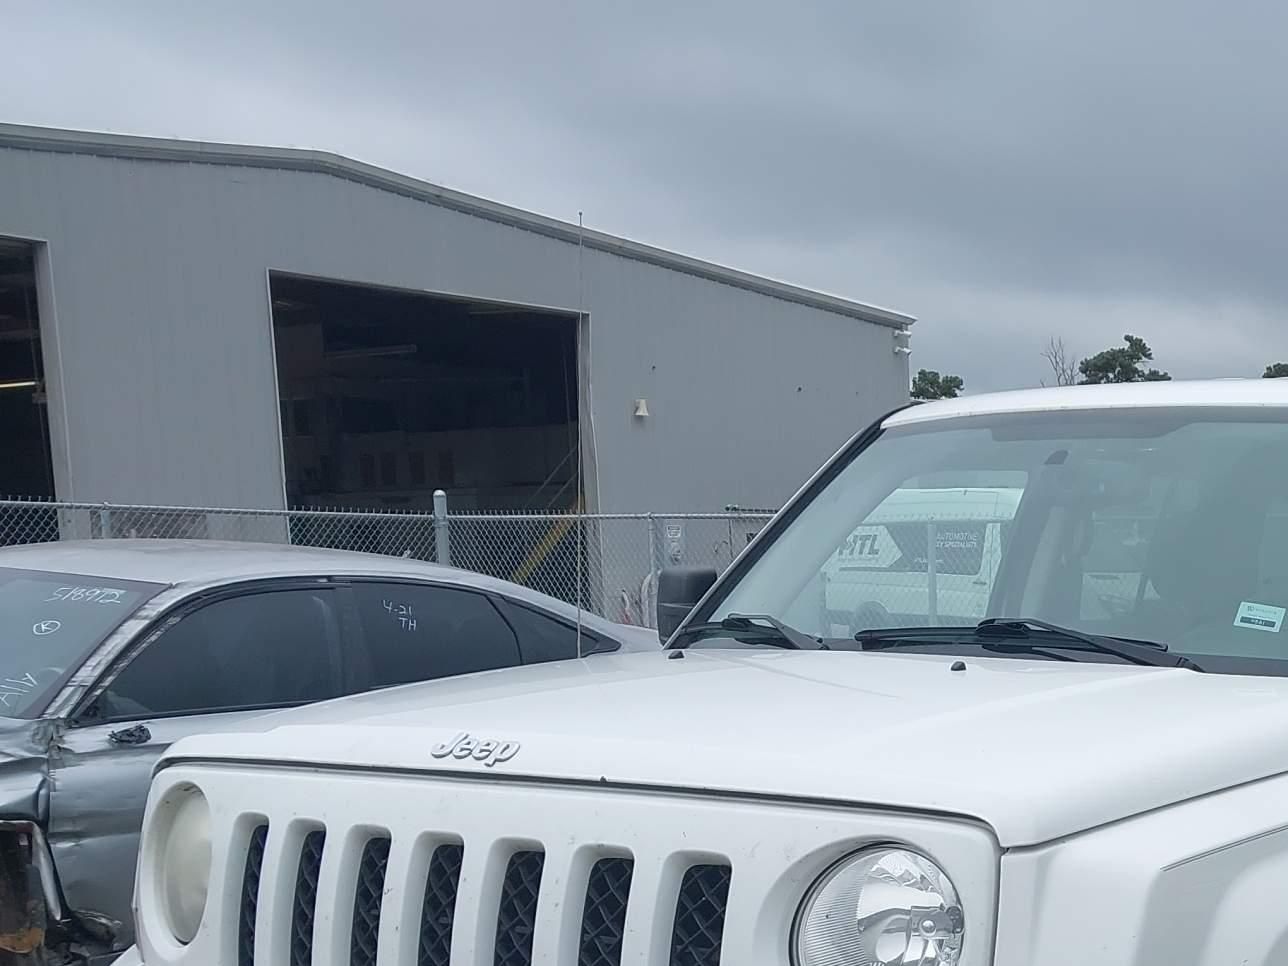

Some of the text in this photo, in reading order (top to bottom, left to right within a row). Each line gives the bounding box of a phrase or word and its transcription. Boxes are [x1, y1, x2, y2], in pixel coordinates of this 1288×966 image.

[383, 600, 412, 615] 4-21
[399, 617, 416, 631] TH
[431, 731, 521, 767] Jeep
